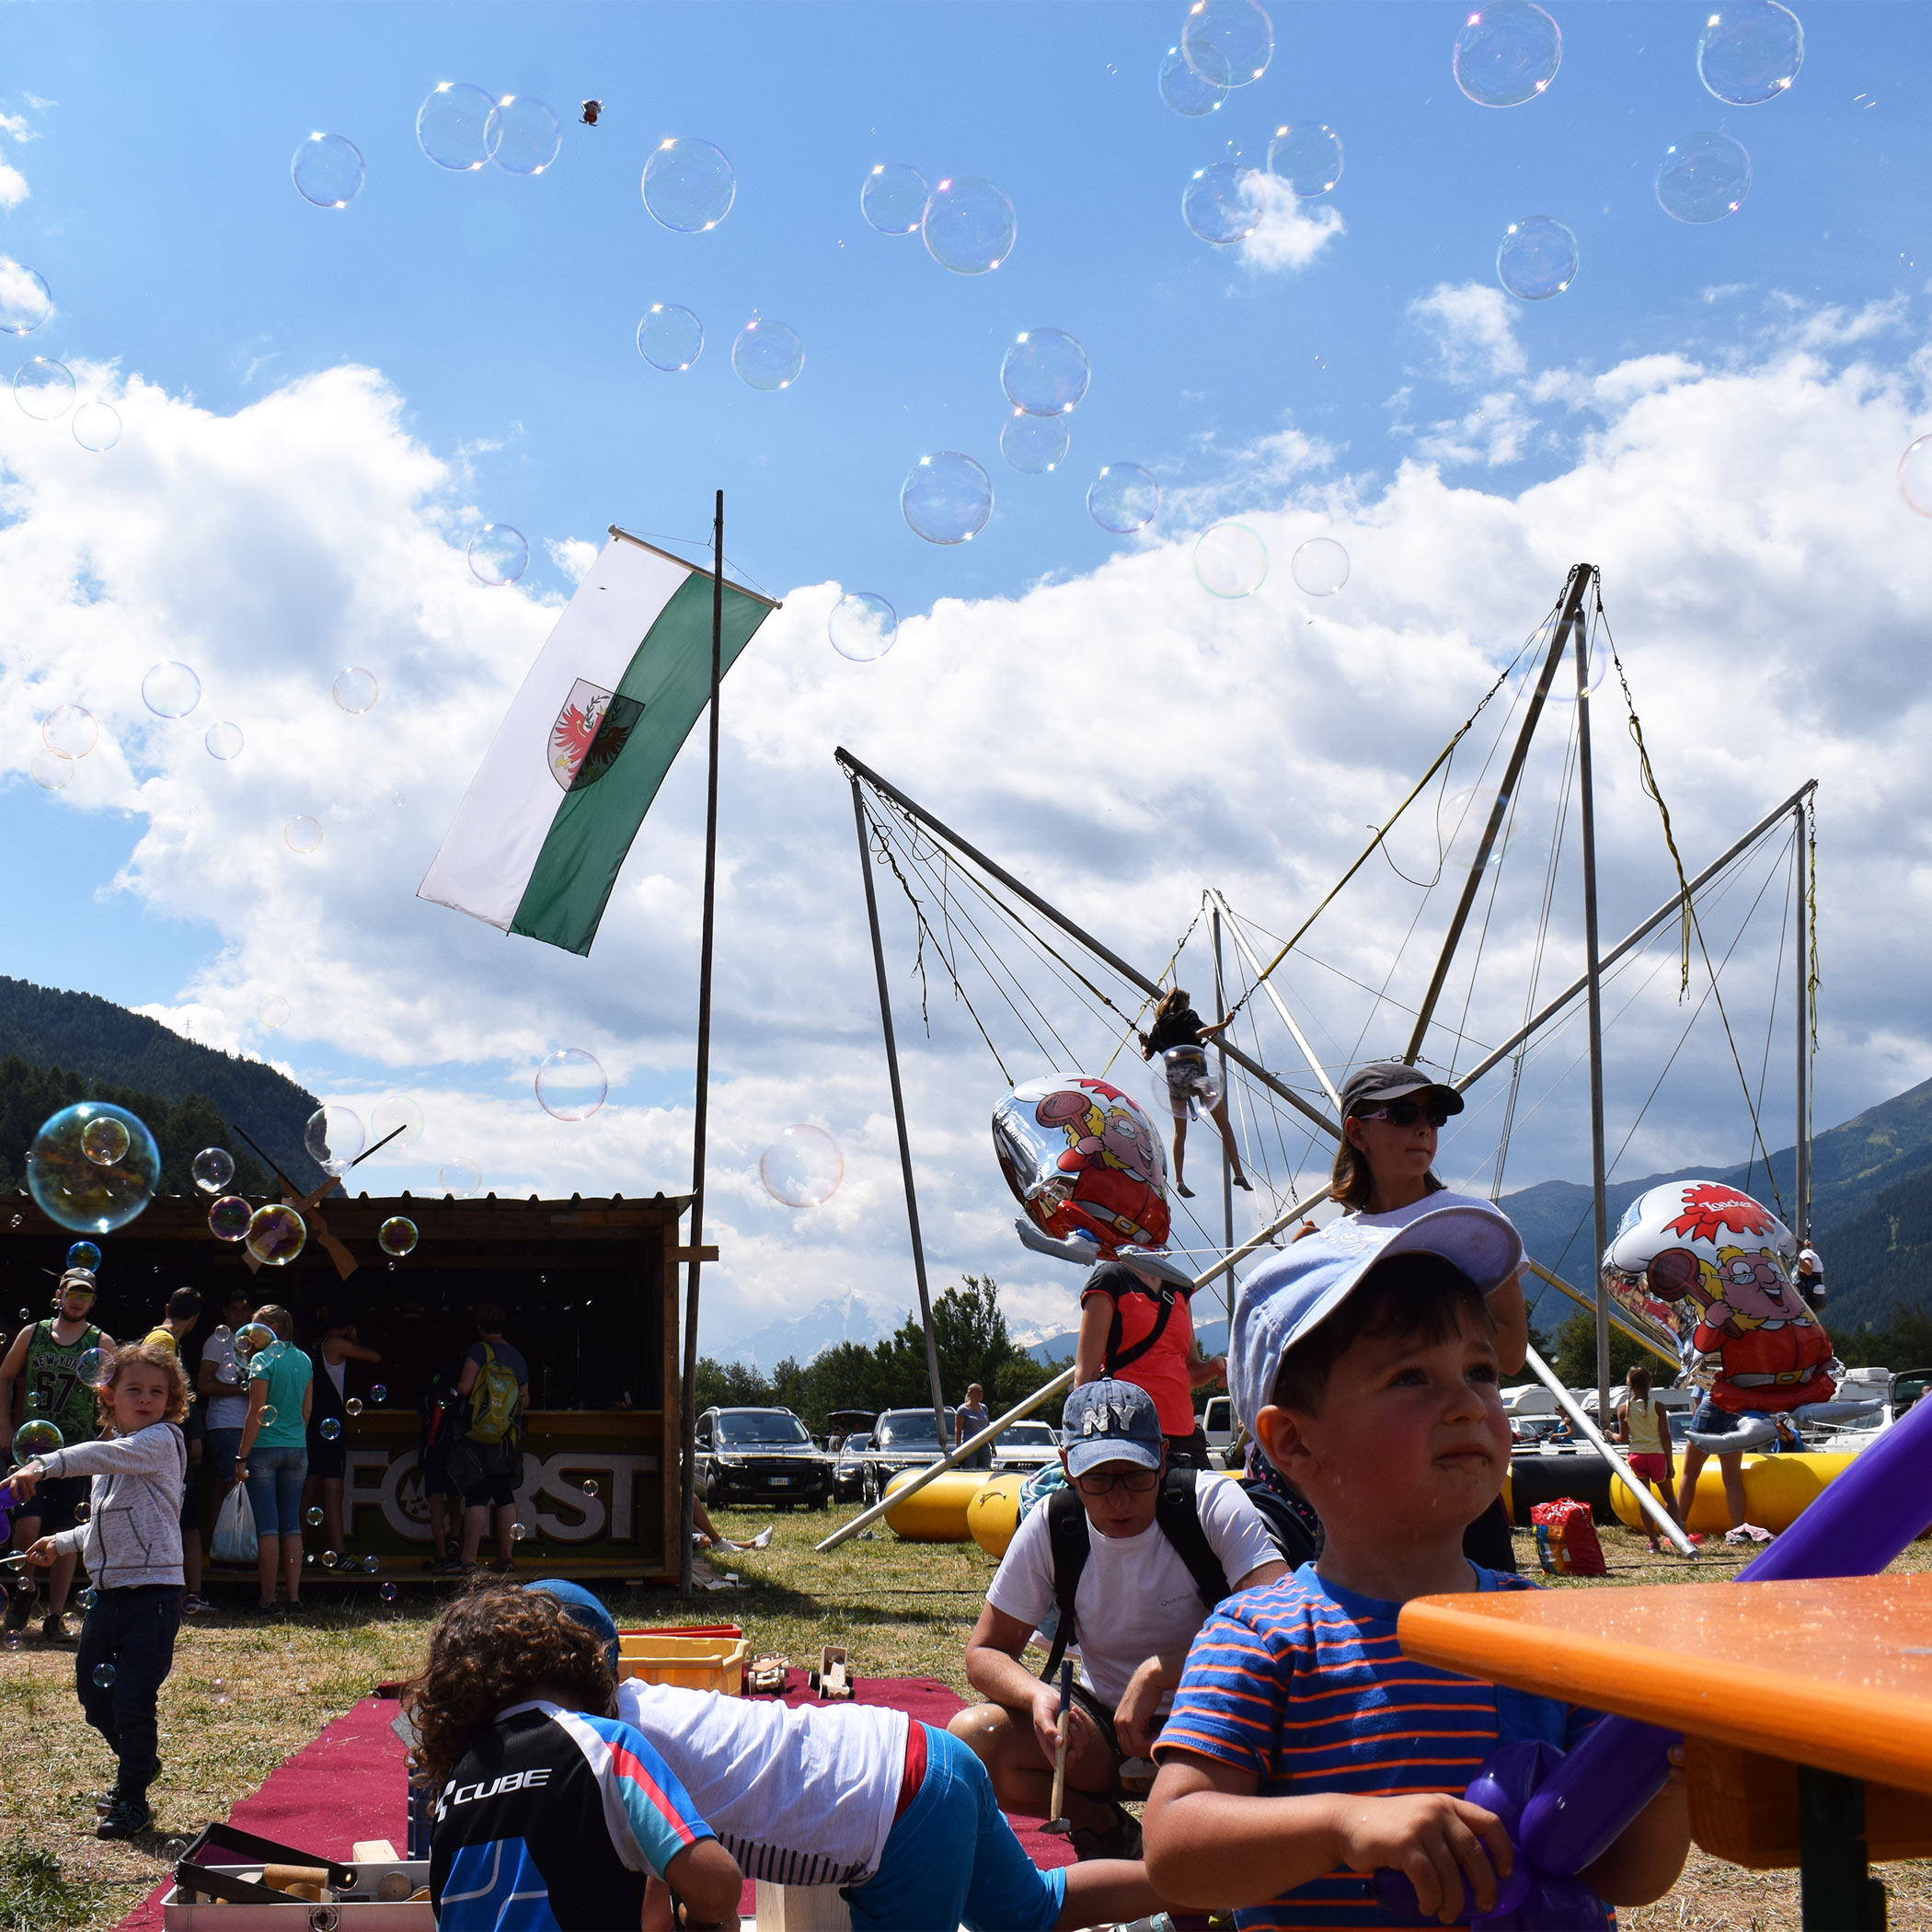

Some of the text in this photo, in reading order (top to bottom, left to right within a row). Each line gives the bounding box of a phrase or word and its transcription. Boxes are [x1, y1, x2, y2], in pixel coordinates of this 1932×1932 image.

[32, 1354, 87, 1374] NEW YORK
[37, 1370, 77, 1413] 67
[1081, 1403, 1136, 1435] NY
[454, 1768, 552, 1805] CUBE
